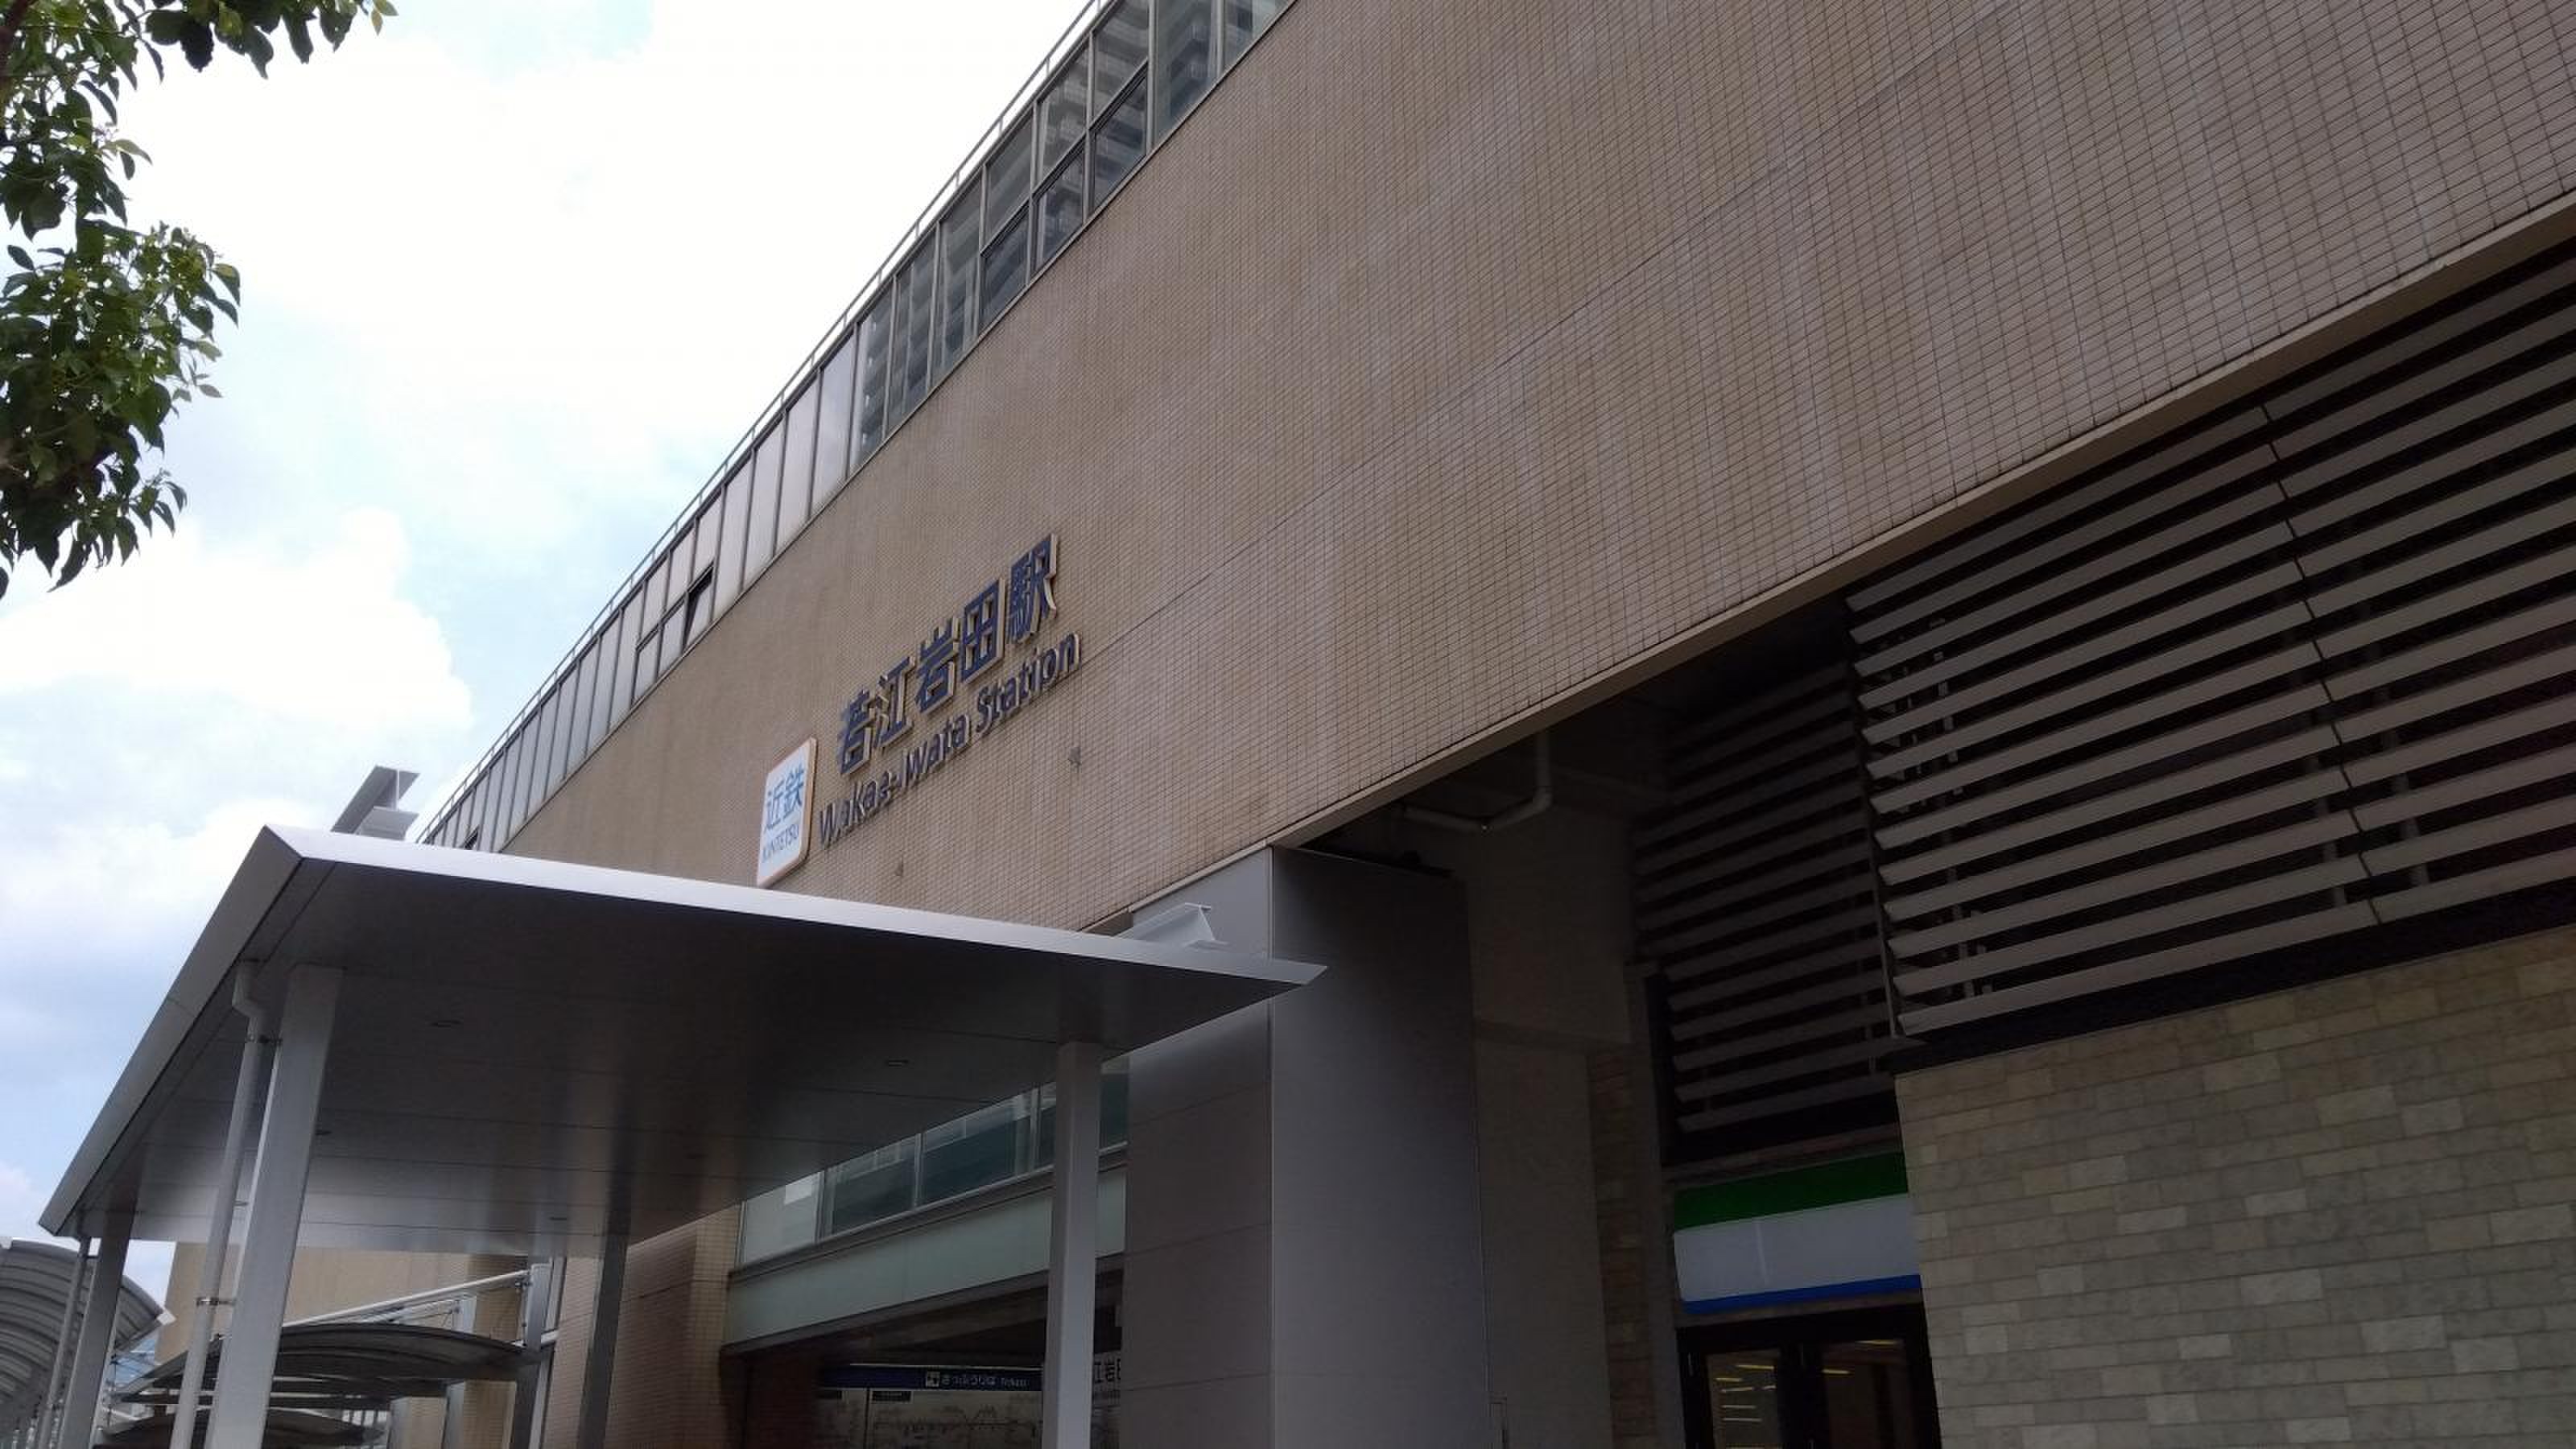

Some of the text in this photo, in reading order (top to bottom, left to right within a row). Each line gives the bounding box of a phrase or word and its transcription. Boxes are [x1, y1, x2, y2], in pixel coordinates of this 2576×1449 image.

[837, 532, 1059, 774] 若江岩田駅
[764, 765, 805, 832] 近鉄
[819, 631, 1081, 851] Wakae-Iwata Station
[762, 824, 800, 862] KINTETSU
